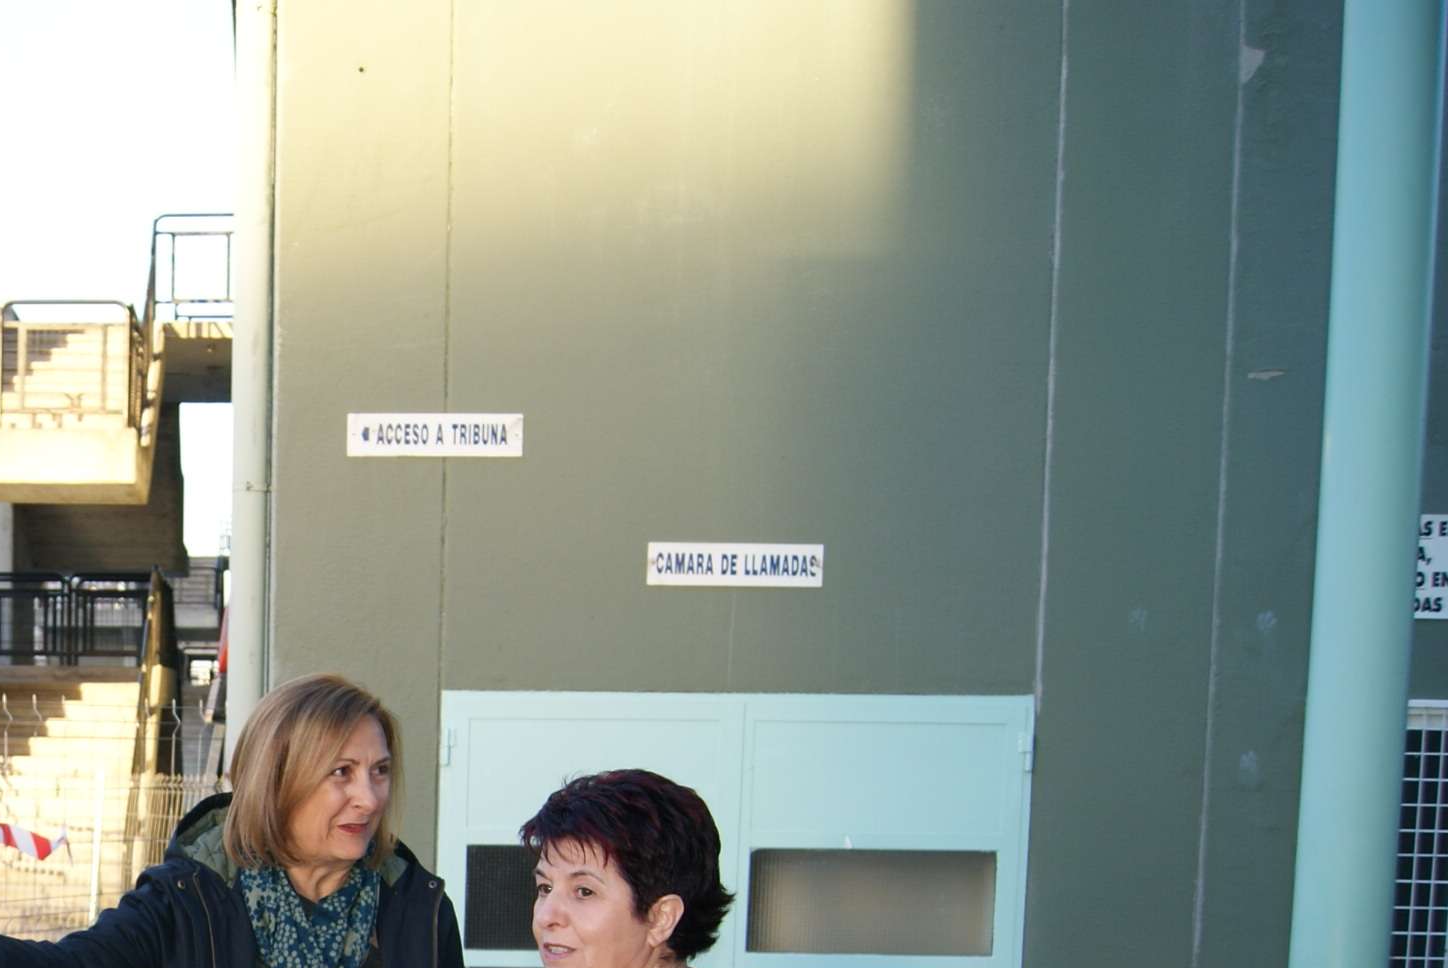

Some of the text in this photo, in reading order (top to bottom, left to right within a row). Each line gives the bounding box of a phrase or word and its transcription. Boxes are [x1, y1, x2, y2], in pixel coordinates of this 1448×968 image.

[376, 423, 508, 446] ACCESO A TRIBUNA
[656, 552, 818, 577] CAMARA DE LLAMADAS
